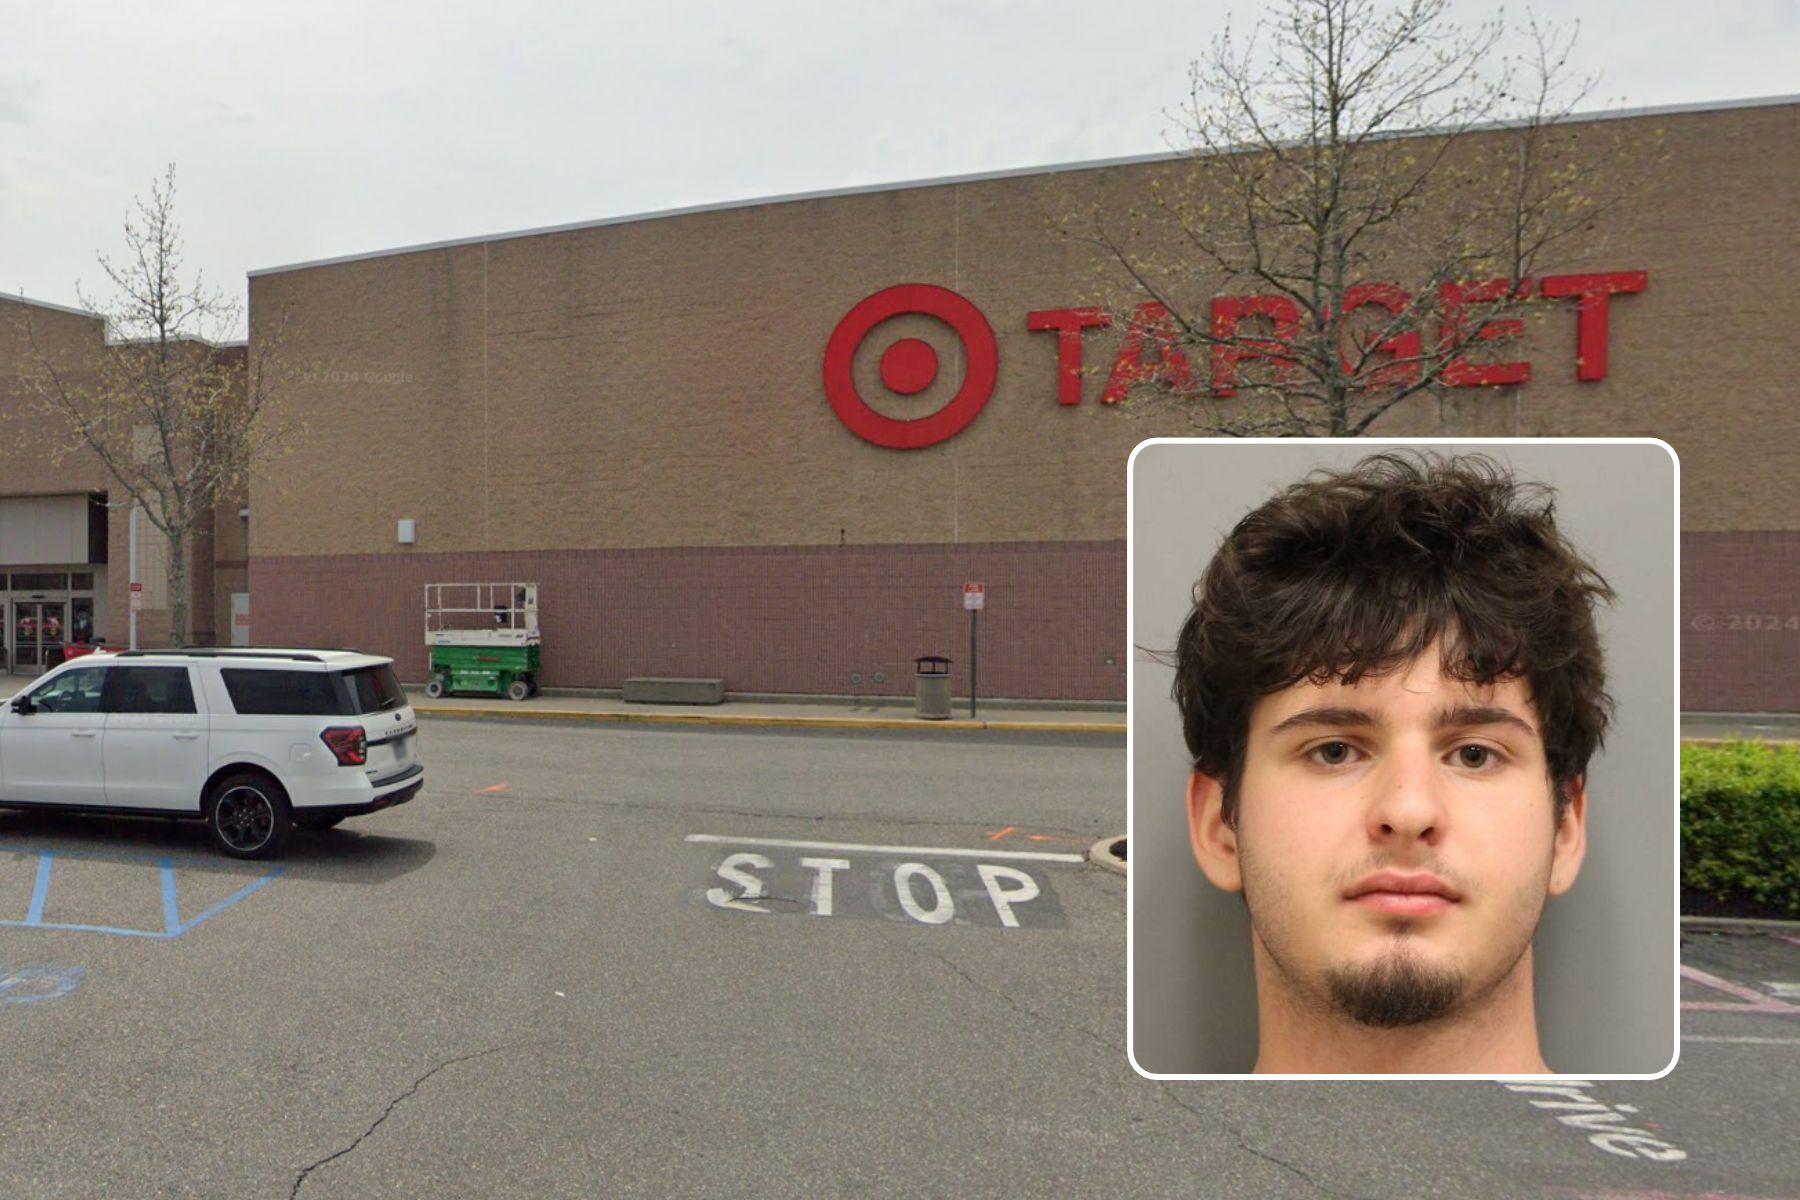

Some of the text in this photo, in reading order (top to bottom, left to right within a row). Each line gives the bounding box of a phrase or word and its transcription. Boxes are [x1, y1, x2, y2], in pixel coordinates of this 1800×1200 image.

[1027, 271, 1647, 405] TARGET
[707, 854, 1040, 927] STOP
[1495, 1080, 1688, 1161] rive
